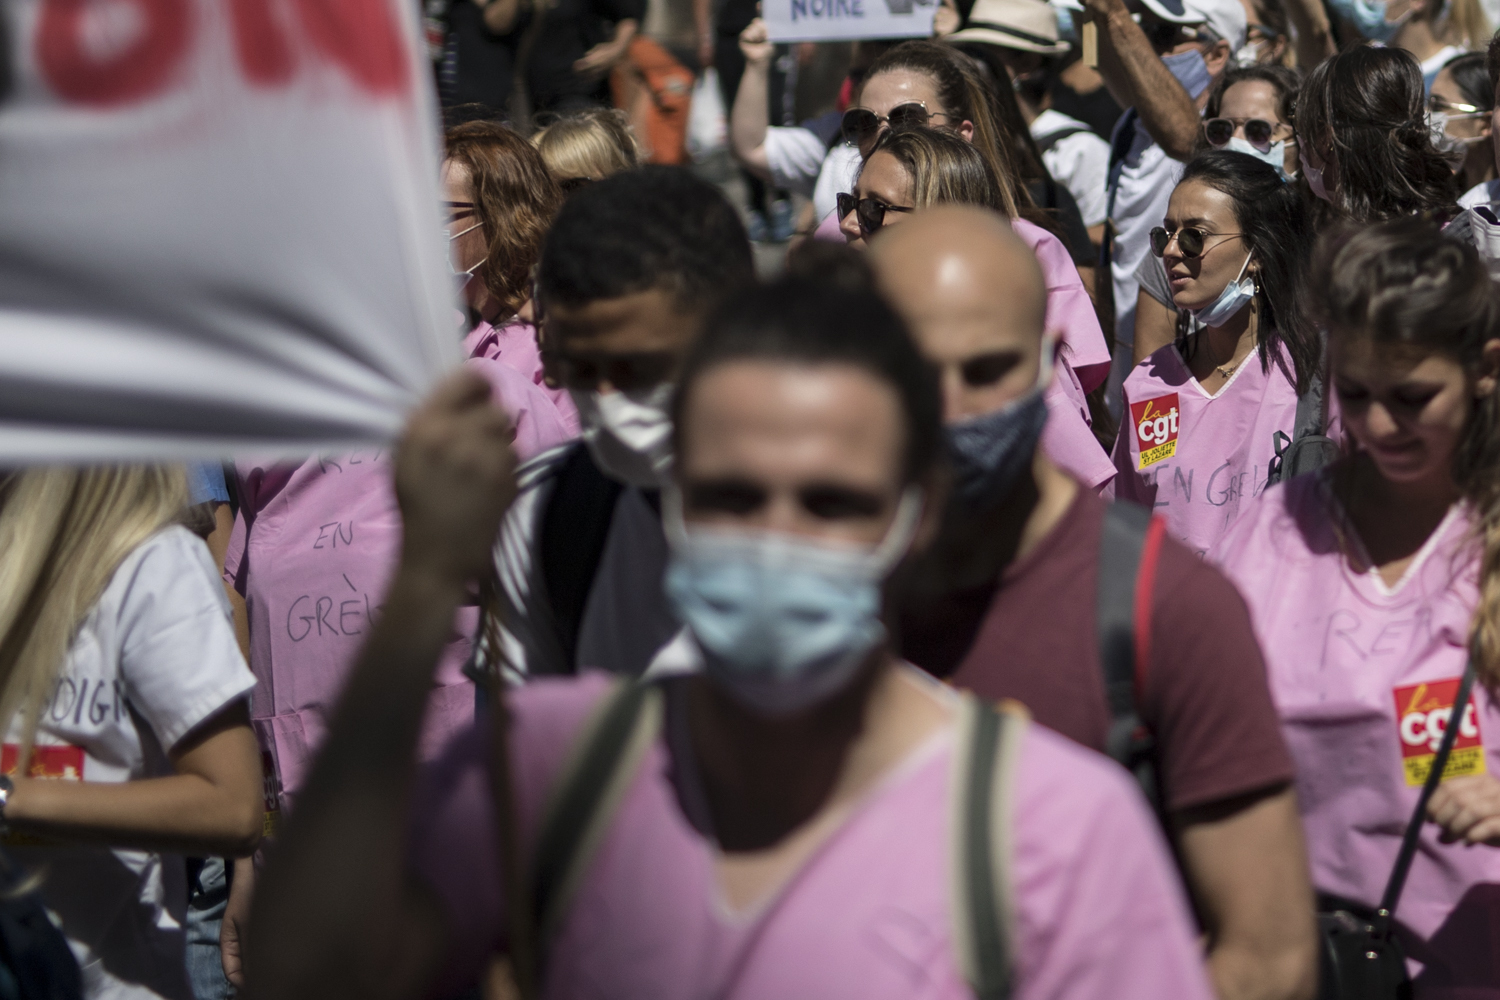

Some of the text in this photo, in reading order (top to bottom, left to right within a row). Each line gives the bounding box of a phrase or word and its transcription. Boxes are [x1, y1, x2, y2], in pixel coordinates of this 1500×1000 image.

[1138, 407, 1179, 445] cgt
[1139, 401, 1169, 424] la
[1141, 441, 1176, 459] UL JOLIETTE
[1143, 456, 1151, 464] ST
[1151, 448, 1172, 461] LAZARE
[313, 521, 353, 550] EN
[1402, 683, 1446, 716] la
[1400, 703, 1478, 752] cgt
